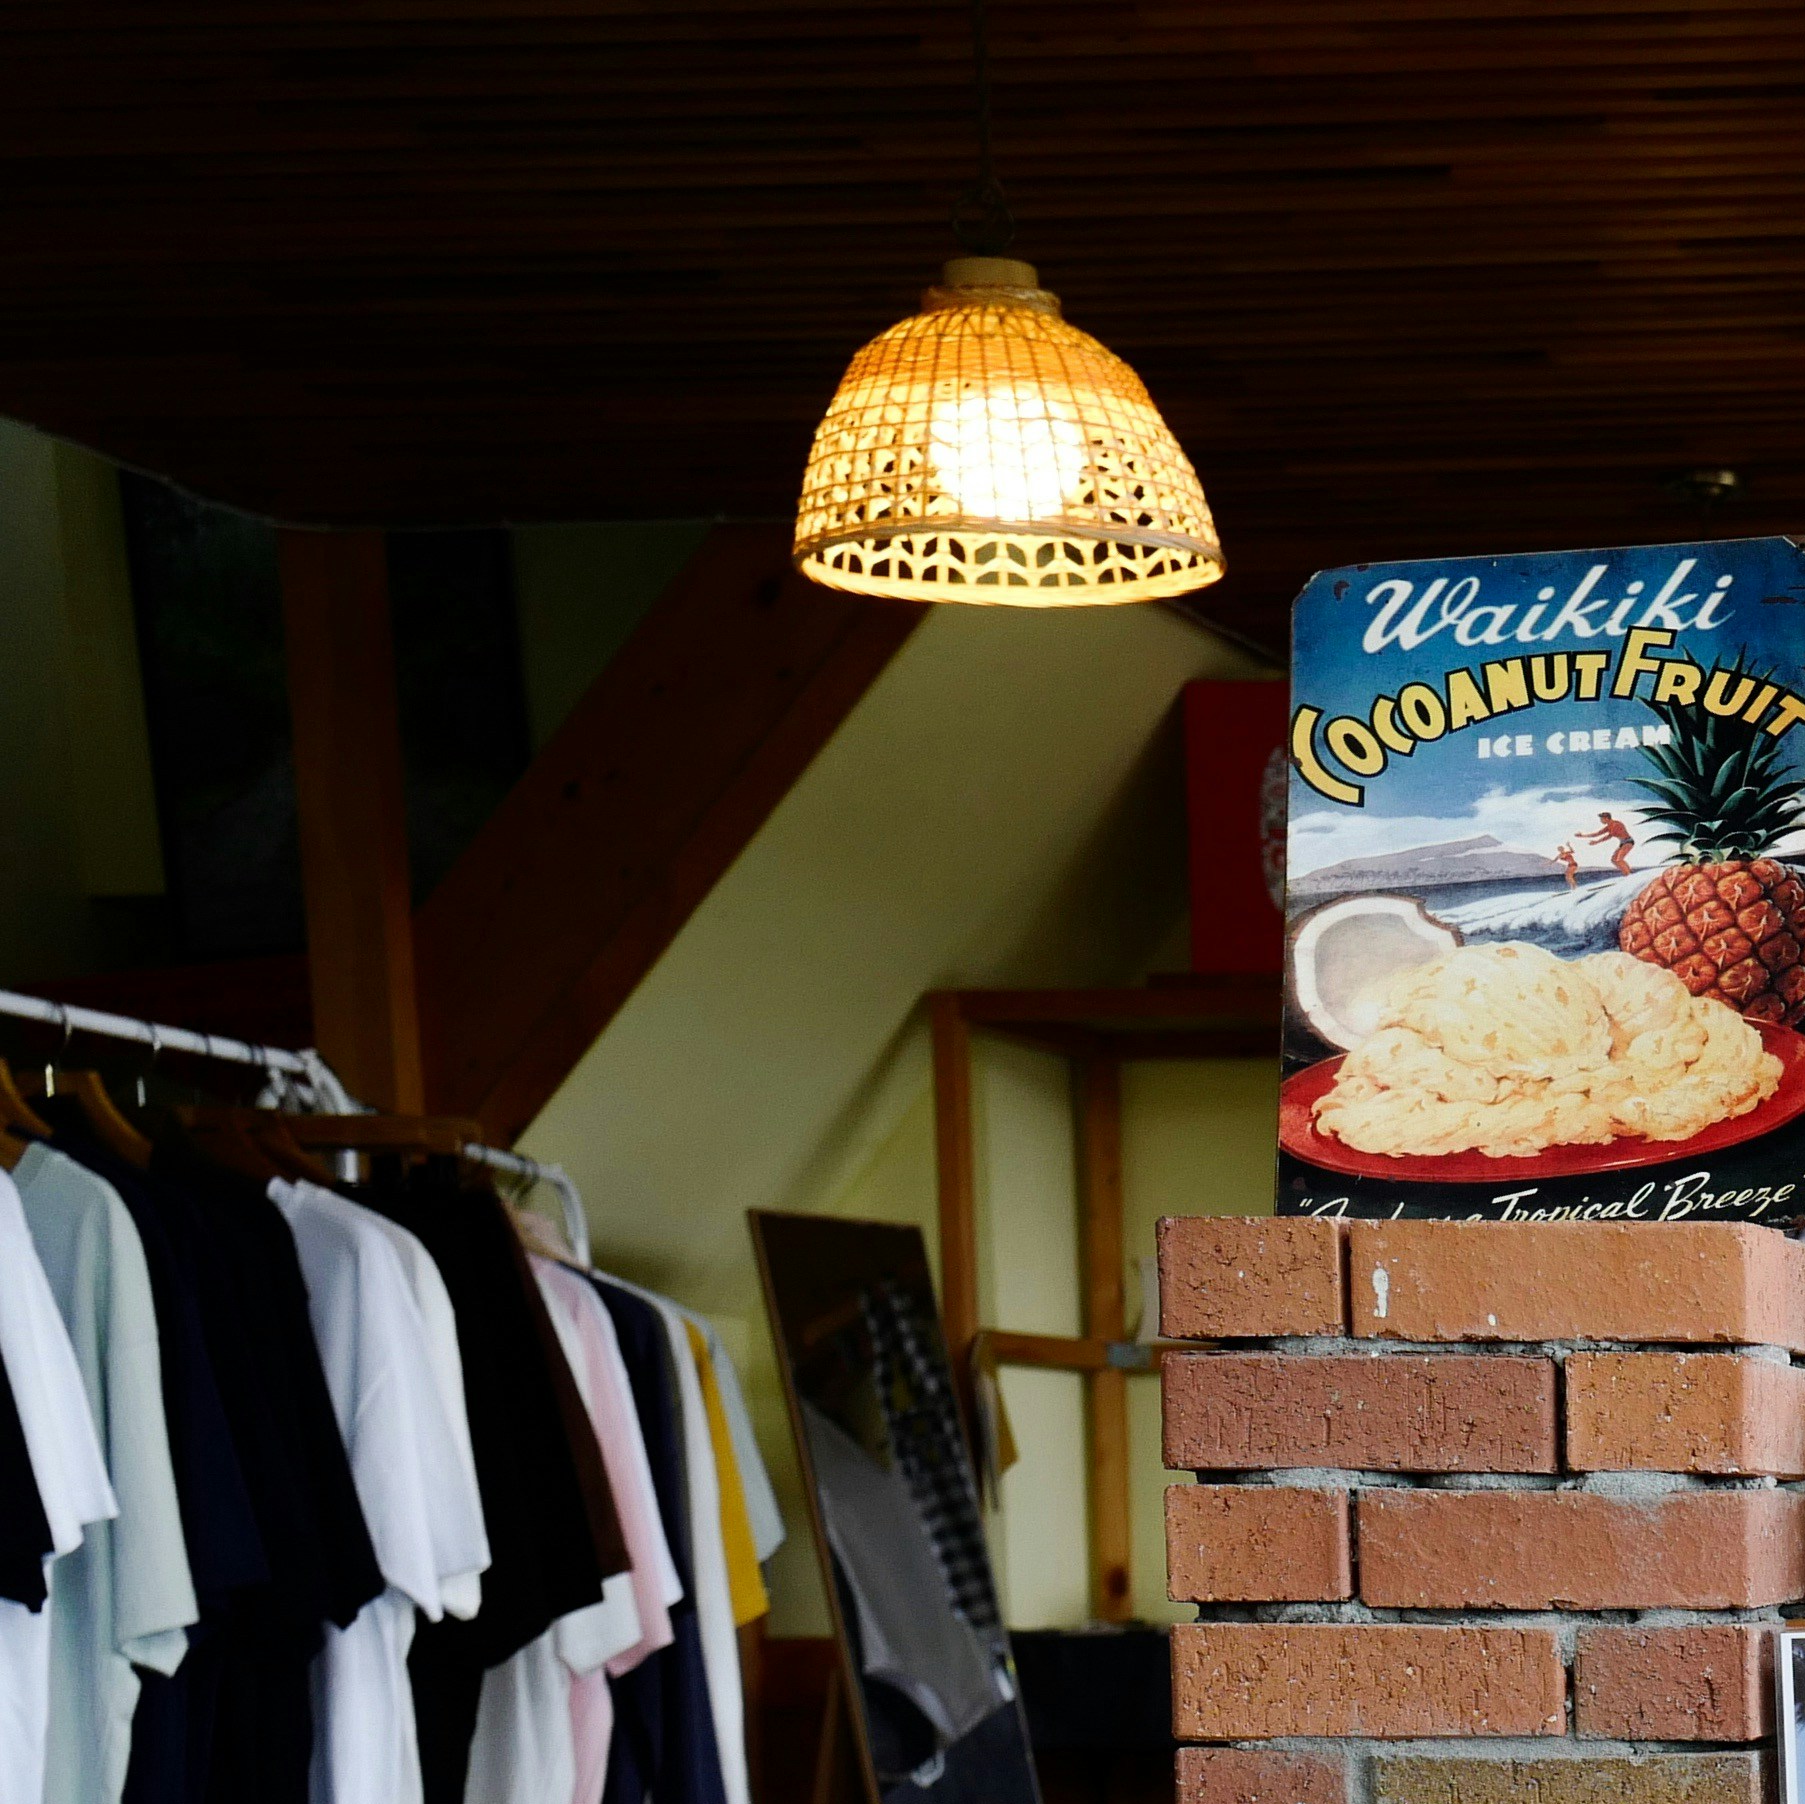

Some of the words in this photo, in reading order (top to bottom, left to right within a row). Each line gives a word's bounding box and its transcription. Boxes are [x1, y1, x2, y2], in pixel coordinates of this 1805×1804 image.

[1362, 558, 1736, 655] Waikiki
[1288, 649, 1609, 808] COCOANUT
[1478, 735, 1534, 760] ICE
[1546, 725, 1670, 755] CREAM
